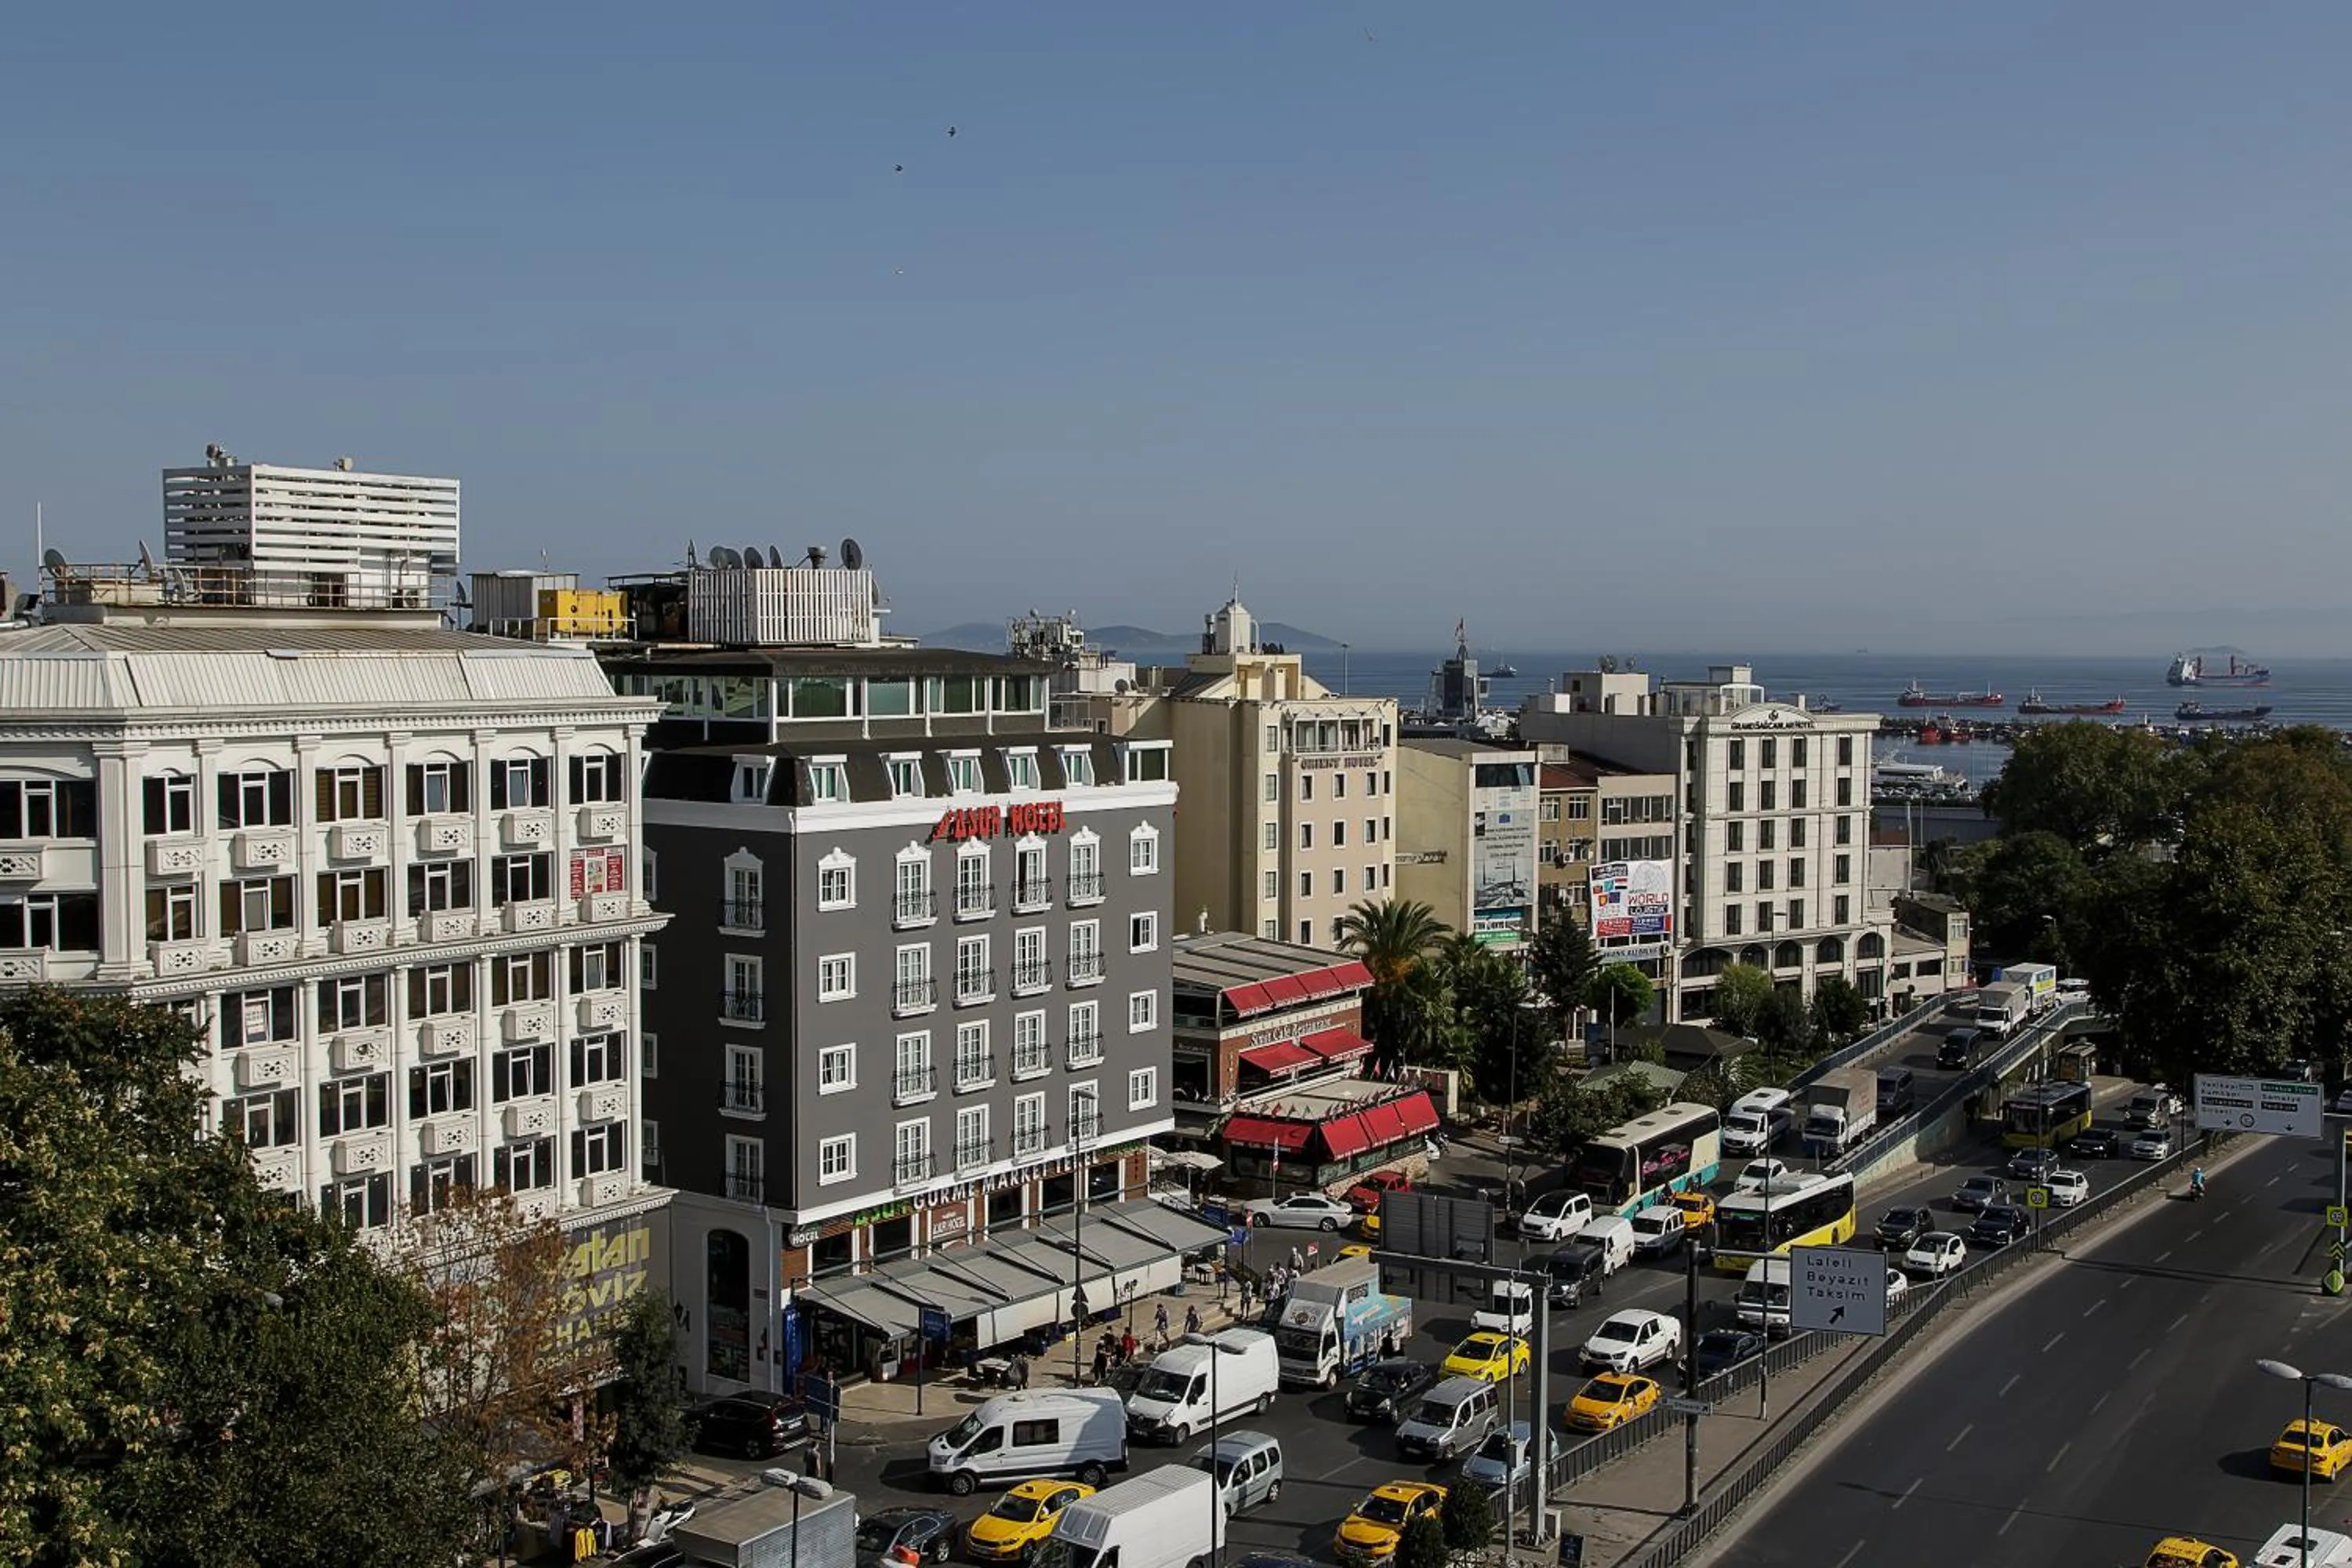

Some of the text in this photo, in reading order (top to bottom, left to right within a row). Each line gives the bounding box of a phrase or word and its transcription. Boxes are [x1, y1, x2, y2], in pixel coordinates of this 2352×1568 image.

[1628, 892, 1669, 906] WORLD
[1807, 1256, 1851, 1267] Laleli
[1807, 1271, 1868, 1285] Beyazıt
[1807, 1287, 1865, 1301] Taksim
